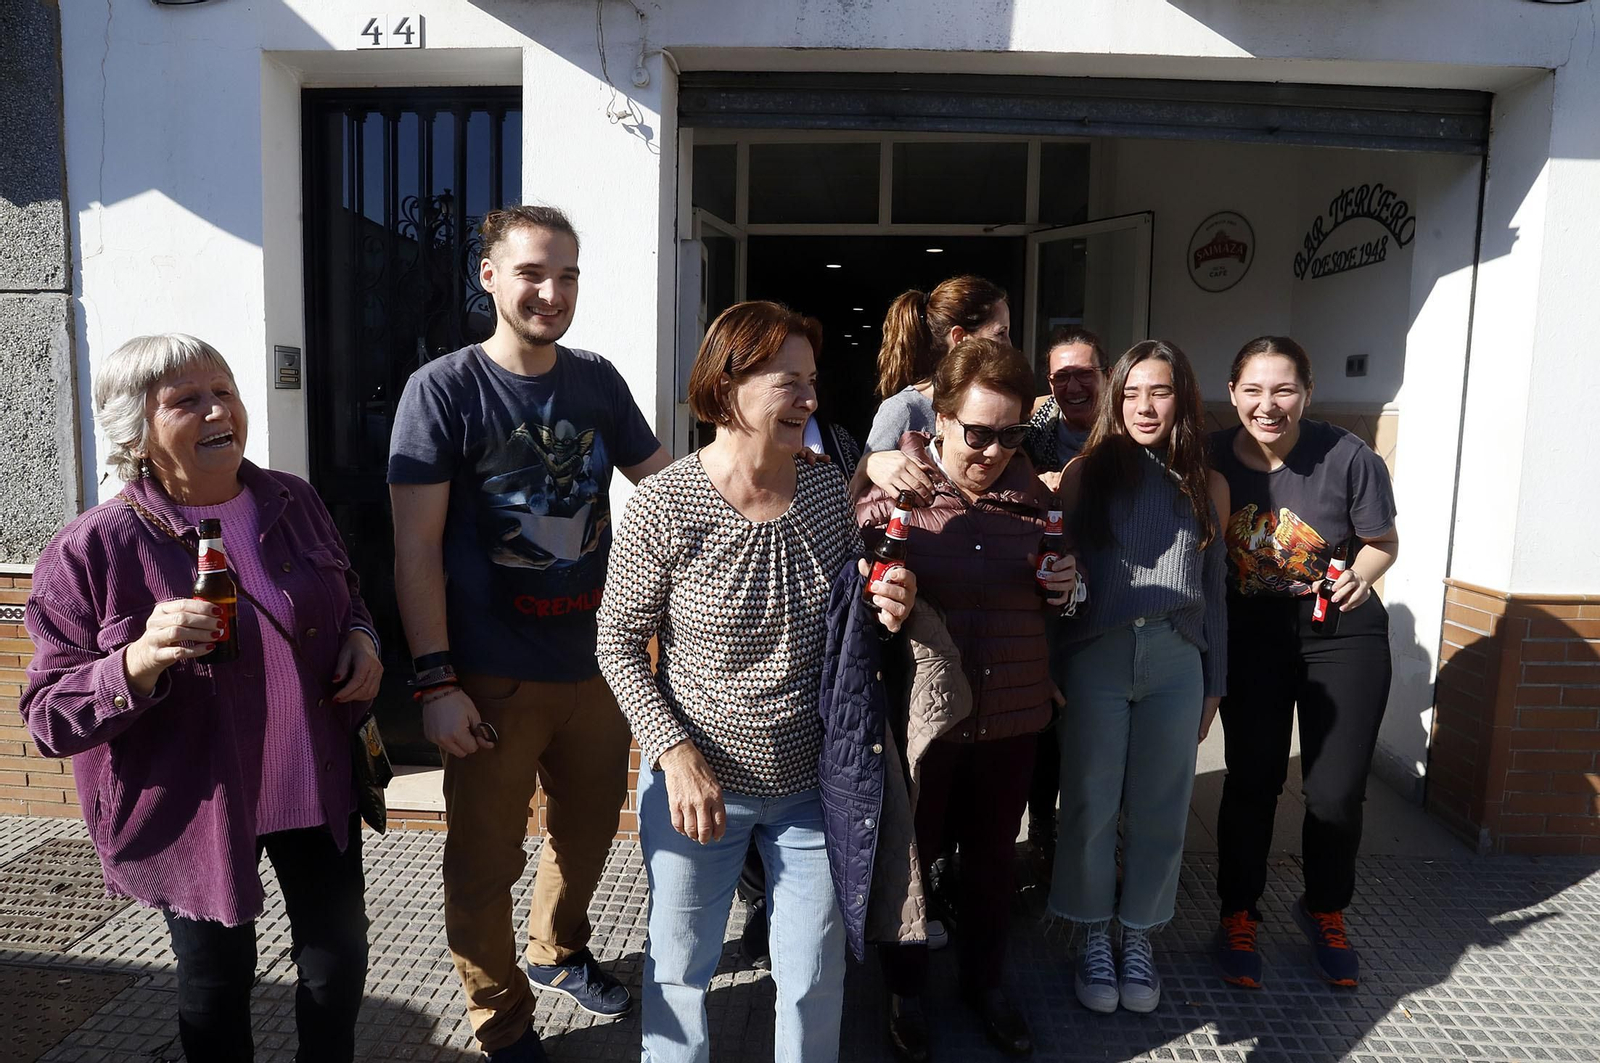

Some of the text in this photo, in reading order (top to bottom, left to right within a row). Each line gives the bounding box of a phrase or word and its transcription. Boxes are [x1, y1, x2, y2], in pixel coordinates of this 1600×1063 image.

[361, 17, 415, 45] 44
[1293, 183, 1416, 280] BAR TERCERO
[1196, 243, 1244, 261] SAIMAZA
[1311, 235, 1389, 277] DESDE 1948
